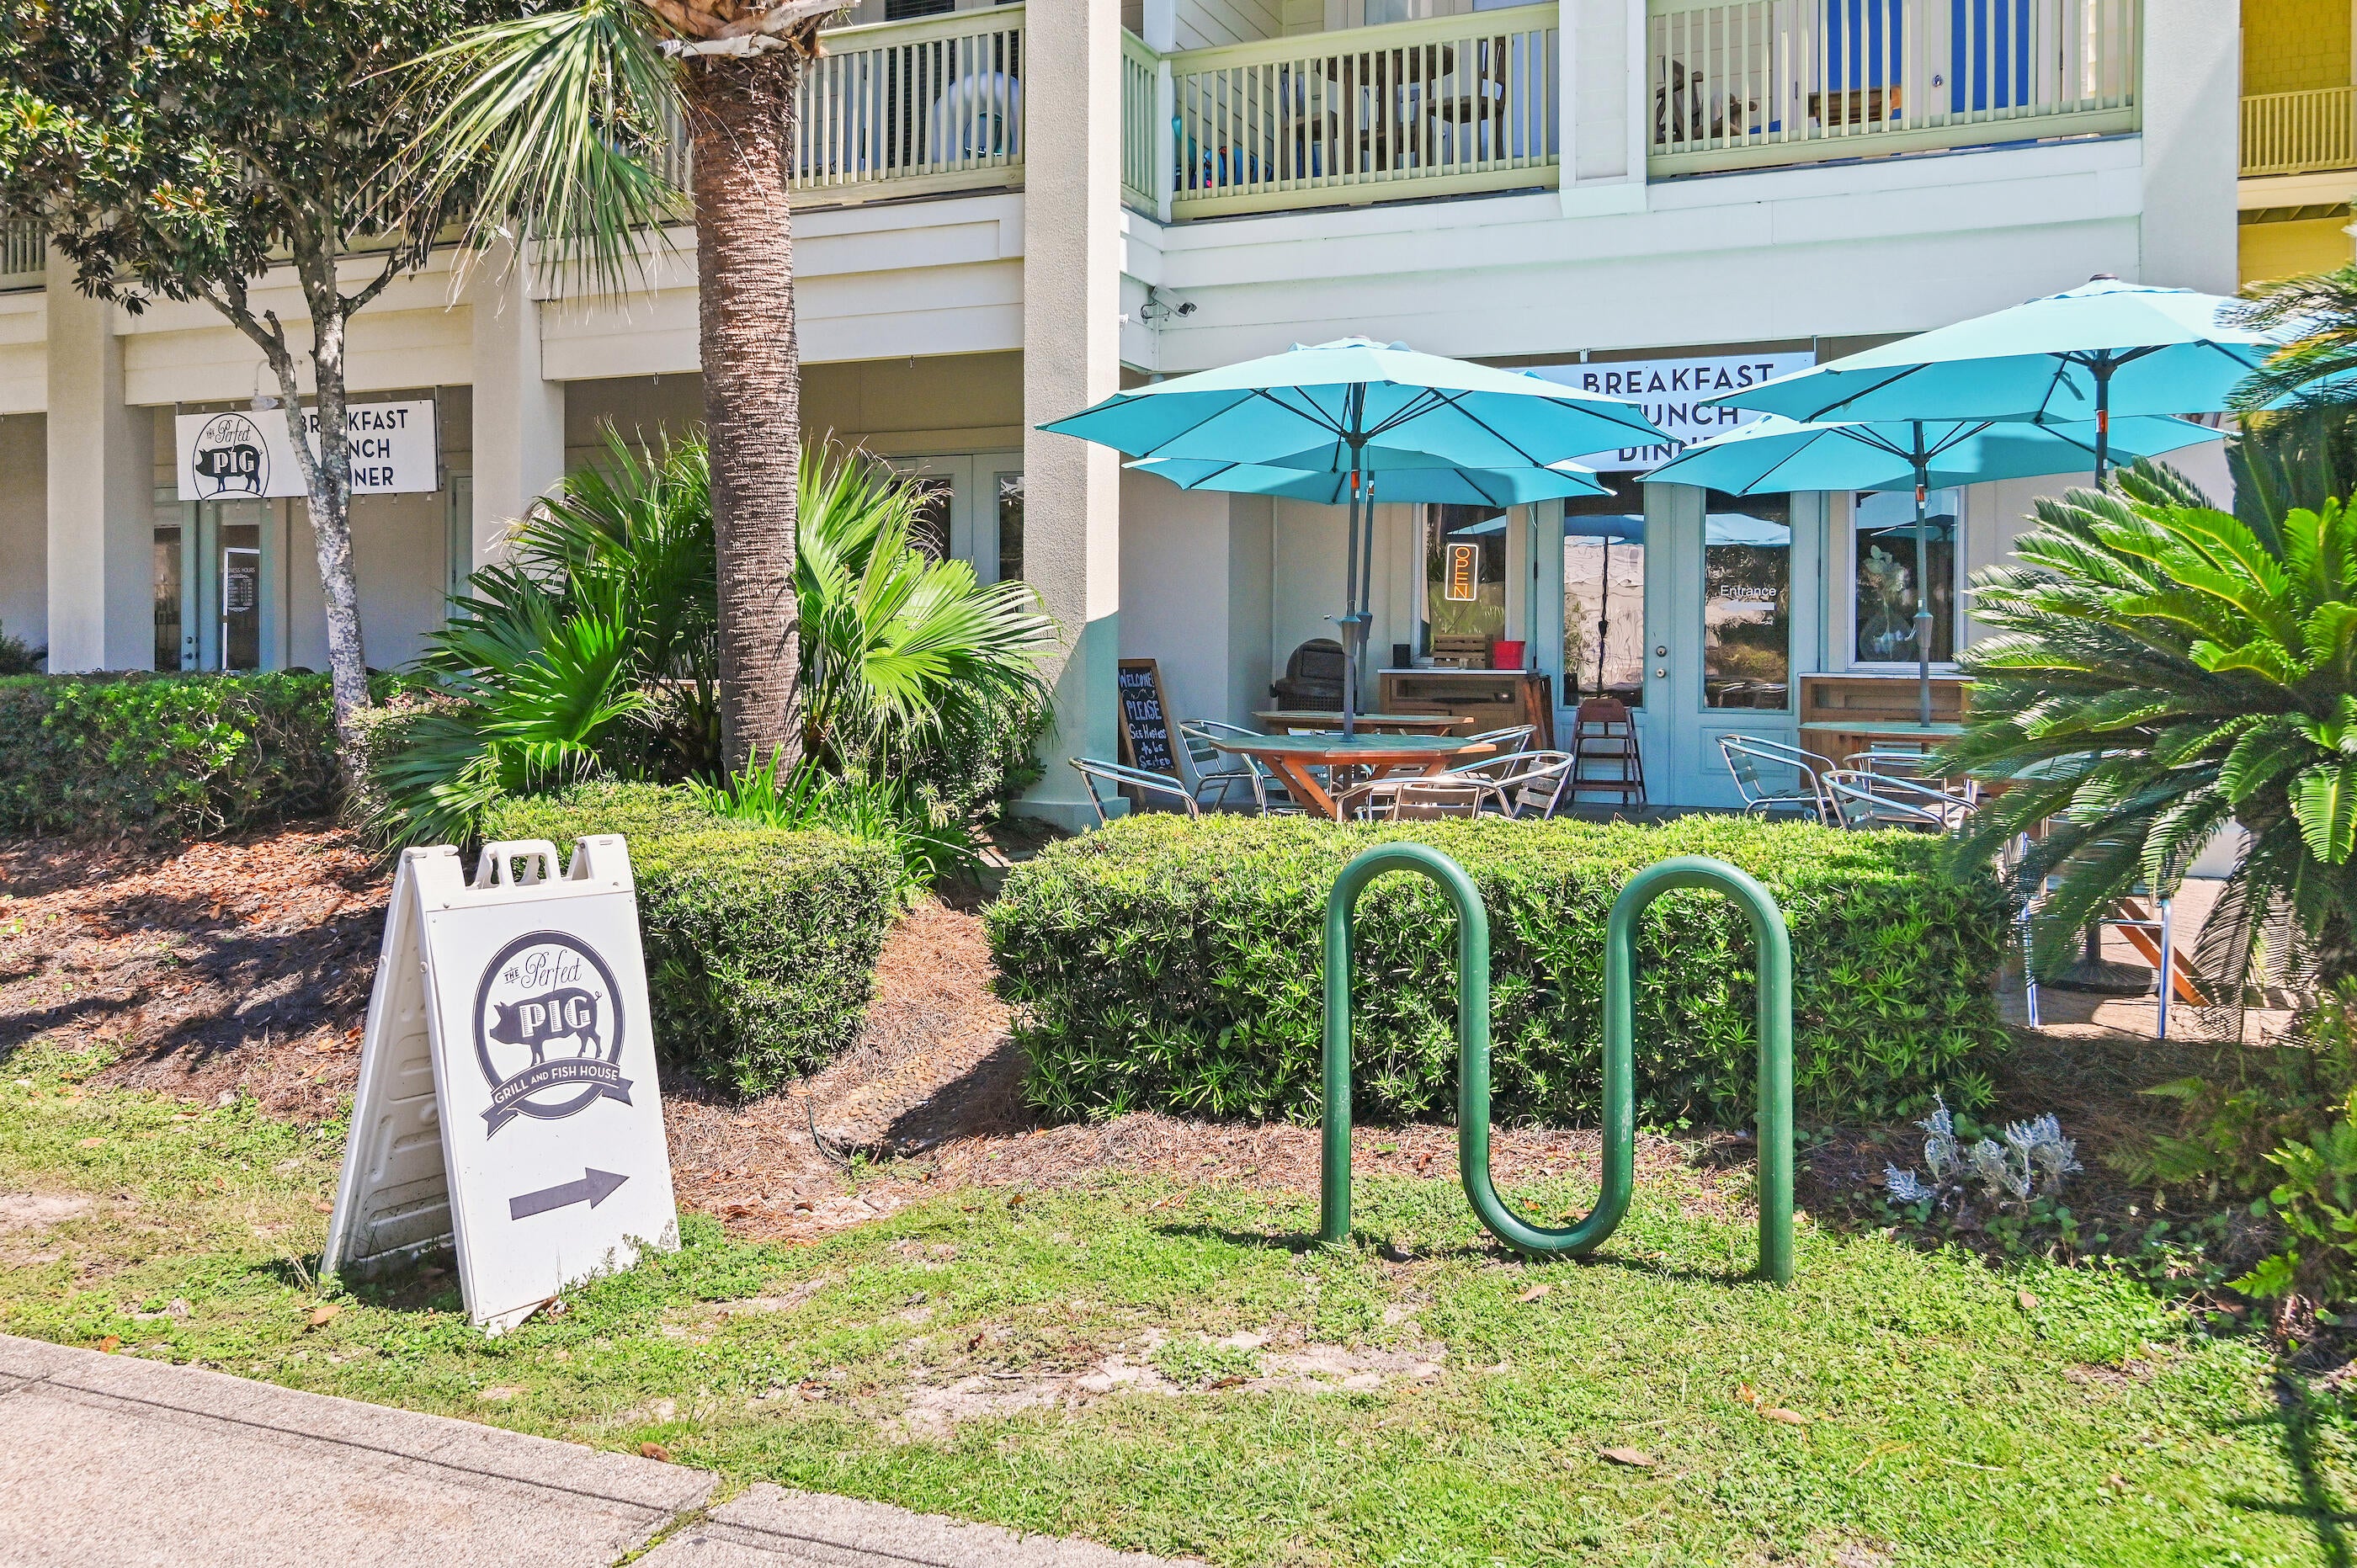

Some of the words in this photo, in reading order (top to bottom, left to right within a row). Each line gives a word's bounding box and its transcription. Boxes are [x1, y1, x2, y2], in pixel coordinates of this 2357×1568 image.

[1583, 364, 1774, 395] BREAKFAST
[301, 409, 408, 433] BRKFAST
[1644, 402, 1738, 427] UNCH
[215, 418, 251, 447] Perfect
[348, 438, 391, 460] NCH
[213, 450, 255, 474] PIG
[354, 466, 394, 486] NER
[1454, 546, 1471, 598] OPEN
[1720, 585, 1777, 597] Entrance
[1118, 669, 1155, 688] WELCOME!
[1126, 699, 1163, 720] PLEASE
[504, 969, 519, 982] THE
[520, 949, 583, 992] Perfect
[519, 996, 592, 1038] PIG
[494, 1079, 529, 1104] GRILL
[530, 1071, 549, 1084] AND
[551, 1066, 577, 1080] FISH
[580, 1065, 619, 1082] HOUSE
